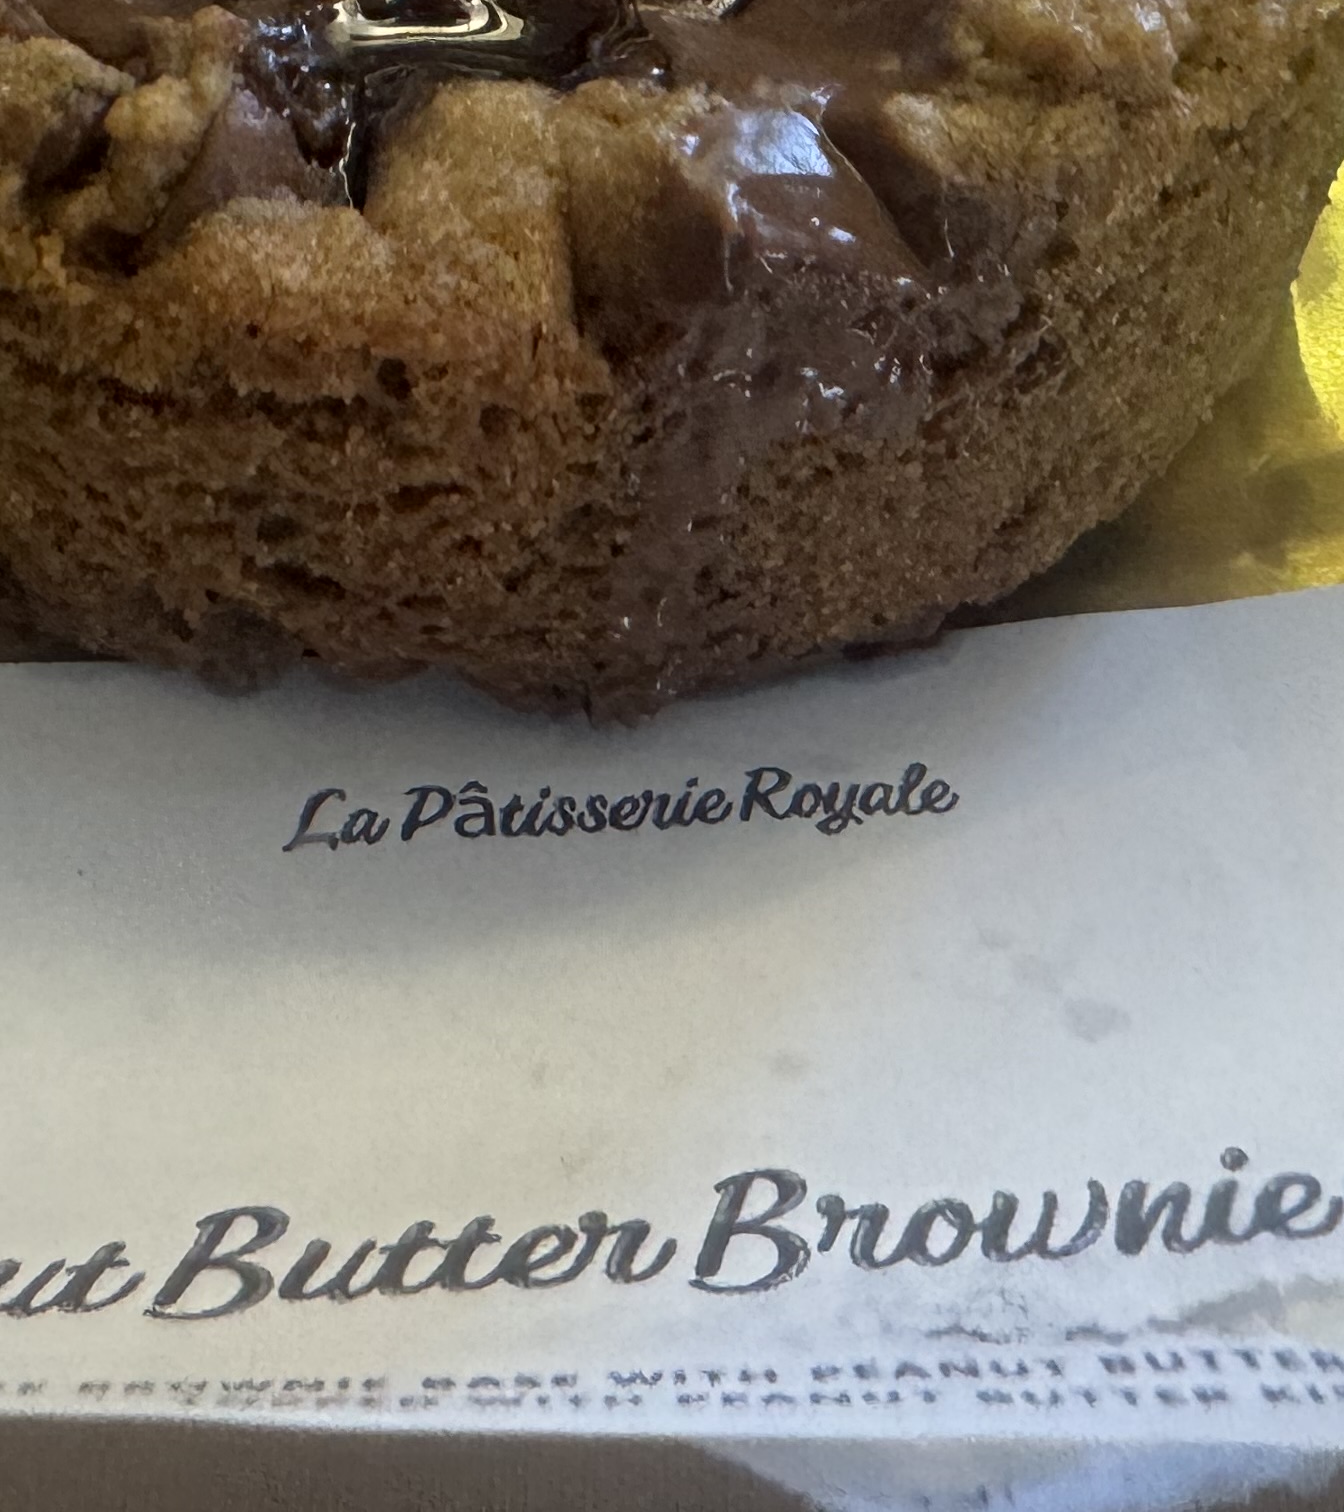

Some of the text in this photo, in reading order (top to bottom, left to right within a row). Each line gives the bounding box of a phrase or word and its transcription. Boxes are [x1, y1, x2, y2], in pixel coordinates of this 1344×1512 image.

[281, 761, 959, 852] La Pâtisserie Royale
[143, 1204, 679, 1321] Butter
[607, 1366, 778, 1387] WITH
[810, 1356, 1066, 1385] PEANUT
